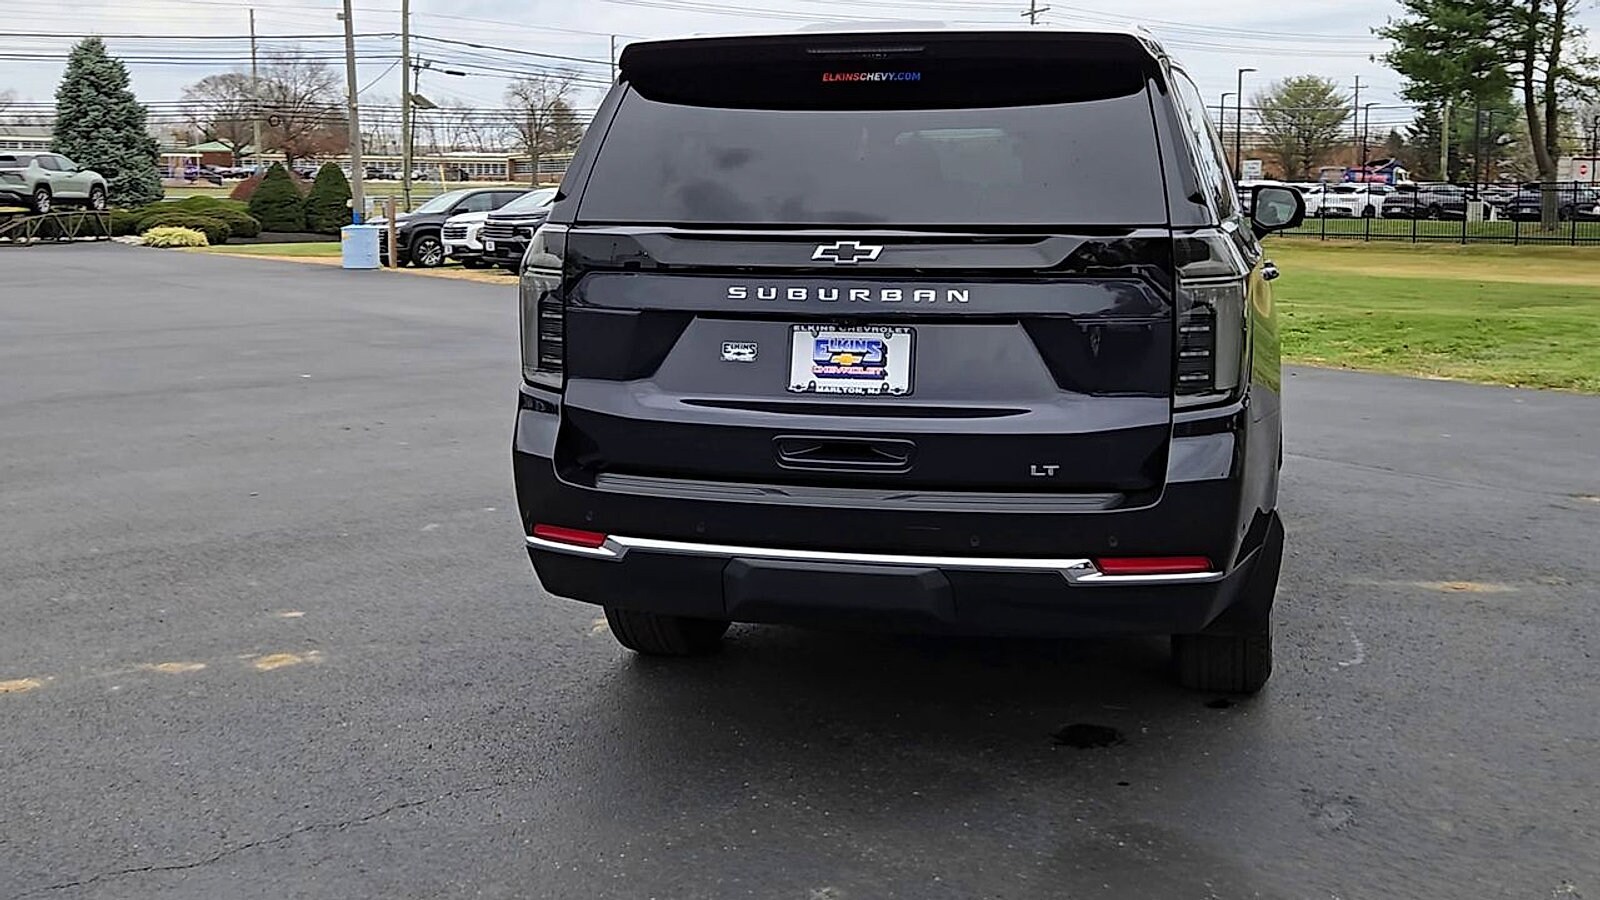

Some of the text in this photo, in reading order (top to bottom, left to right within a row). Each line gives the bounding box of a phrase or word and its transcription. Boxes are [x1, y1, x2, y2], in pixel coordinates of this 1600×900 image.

[822, 72, 921, 81] ELKINSCHEVY.COM
[727, 286, 969, 303] SUBURBAN
[813, 338, 883, 361] ELKINS
[1030, 465, 1060, 476] LT
